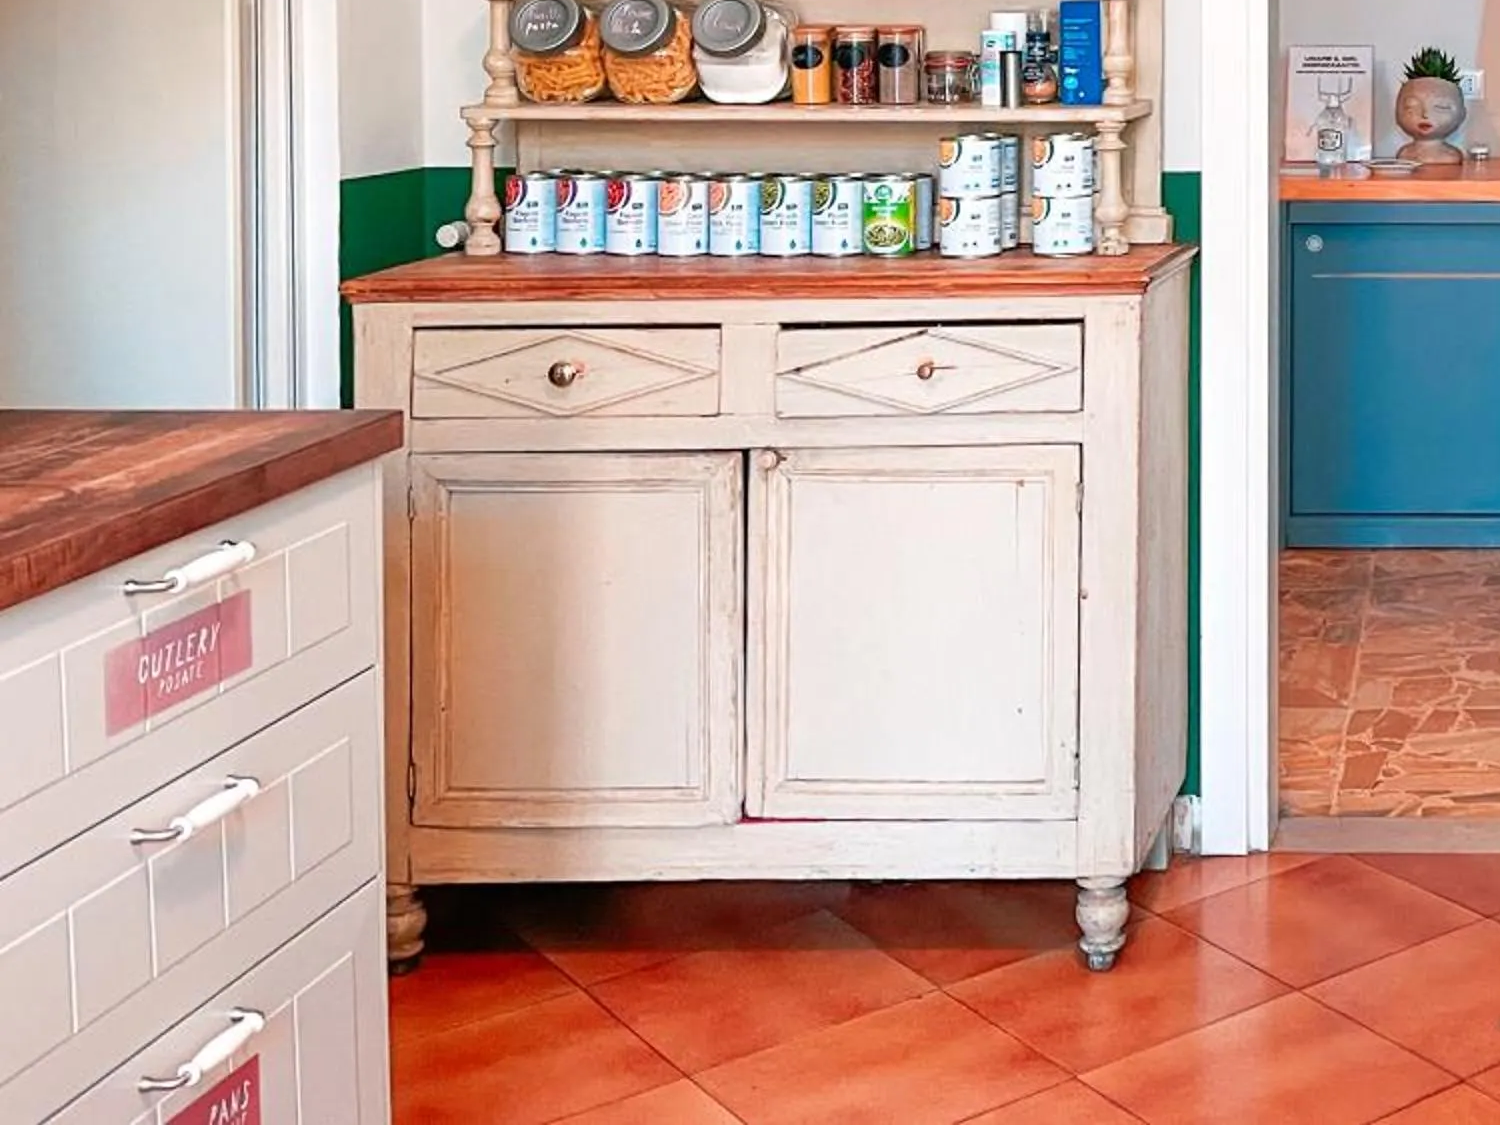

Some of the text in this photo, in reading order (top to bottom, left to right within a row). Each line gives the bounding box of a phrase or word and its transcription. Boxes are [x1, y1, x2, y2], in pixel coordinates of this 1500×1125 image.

[138, 622, 220, 684] CUTLERY
[158, 661, 205, 697] POSATE
[209, 1079, 252, 1125] PANS
